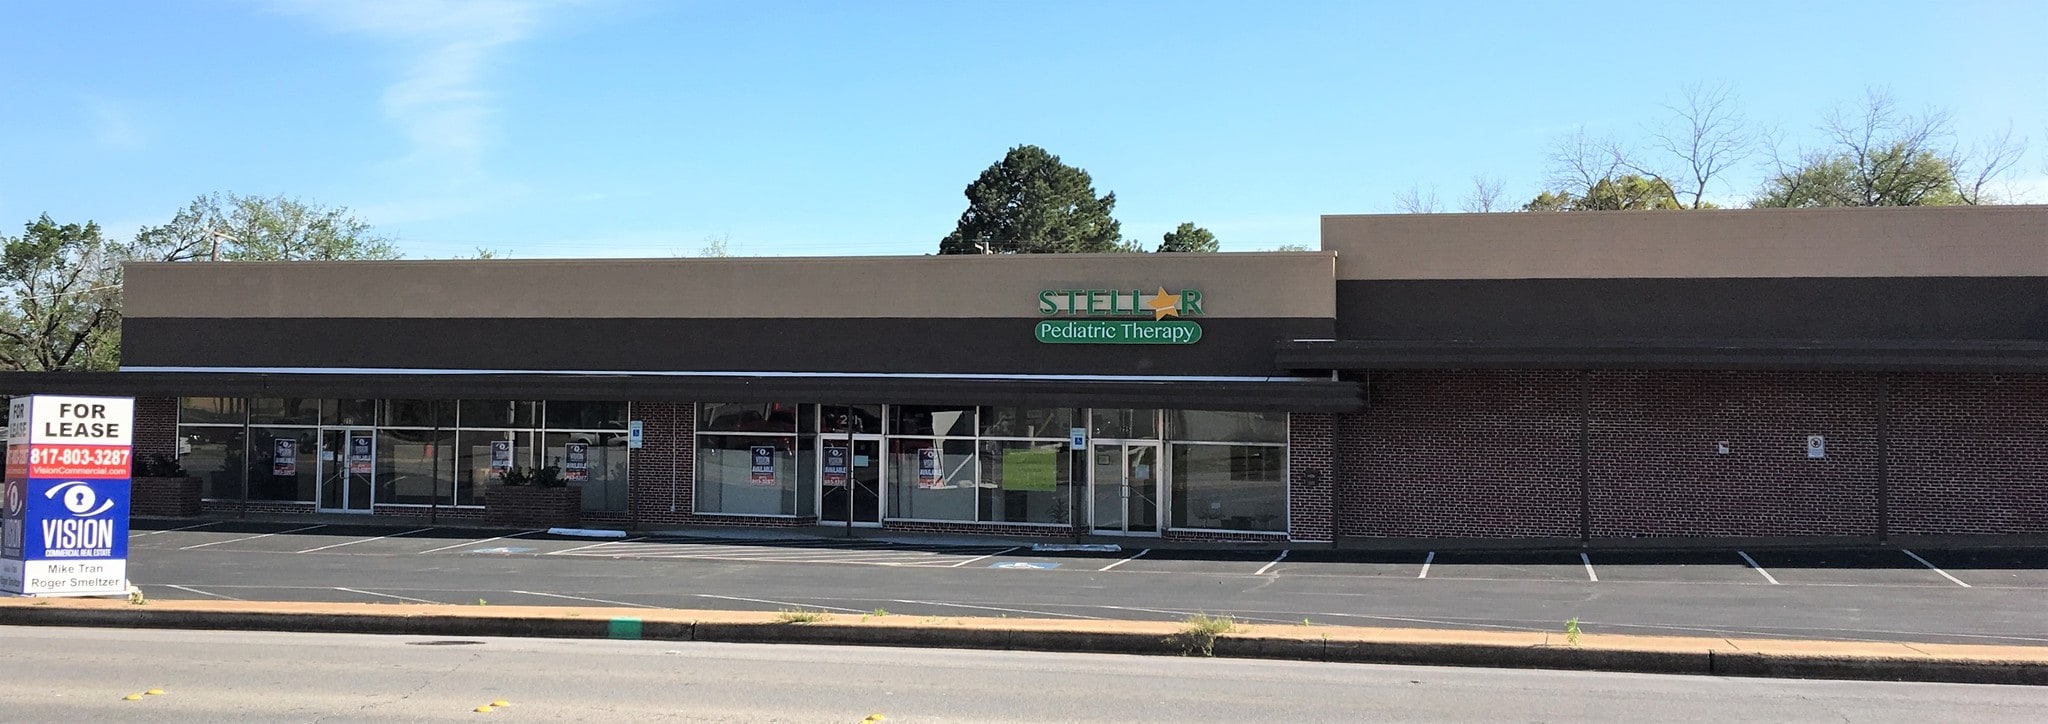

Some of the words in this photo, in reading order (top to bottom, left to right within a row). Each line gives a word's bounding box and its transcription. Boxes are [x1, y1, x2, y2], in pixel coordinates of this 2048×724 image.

[1041, 322, 1116, 338] Pediatric
[1121, 322, 1194, 342] Therapy
[60, 403, 106, 419] FOR
[45, 422, 119, 438] LEASE
[30, 448, 130, 465] 817-803-3287
[33, 466, 127, 475] VisionCommercial.com
[42, 519, 113, 549] VISION
[48, 565, 75, 573] Mike
[79, 565, 103, 573] Tran
[31, 579, 66, 590] Roger
[70, 578, 119, 588] Smeltzer
